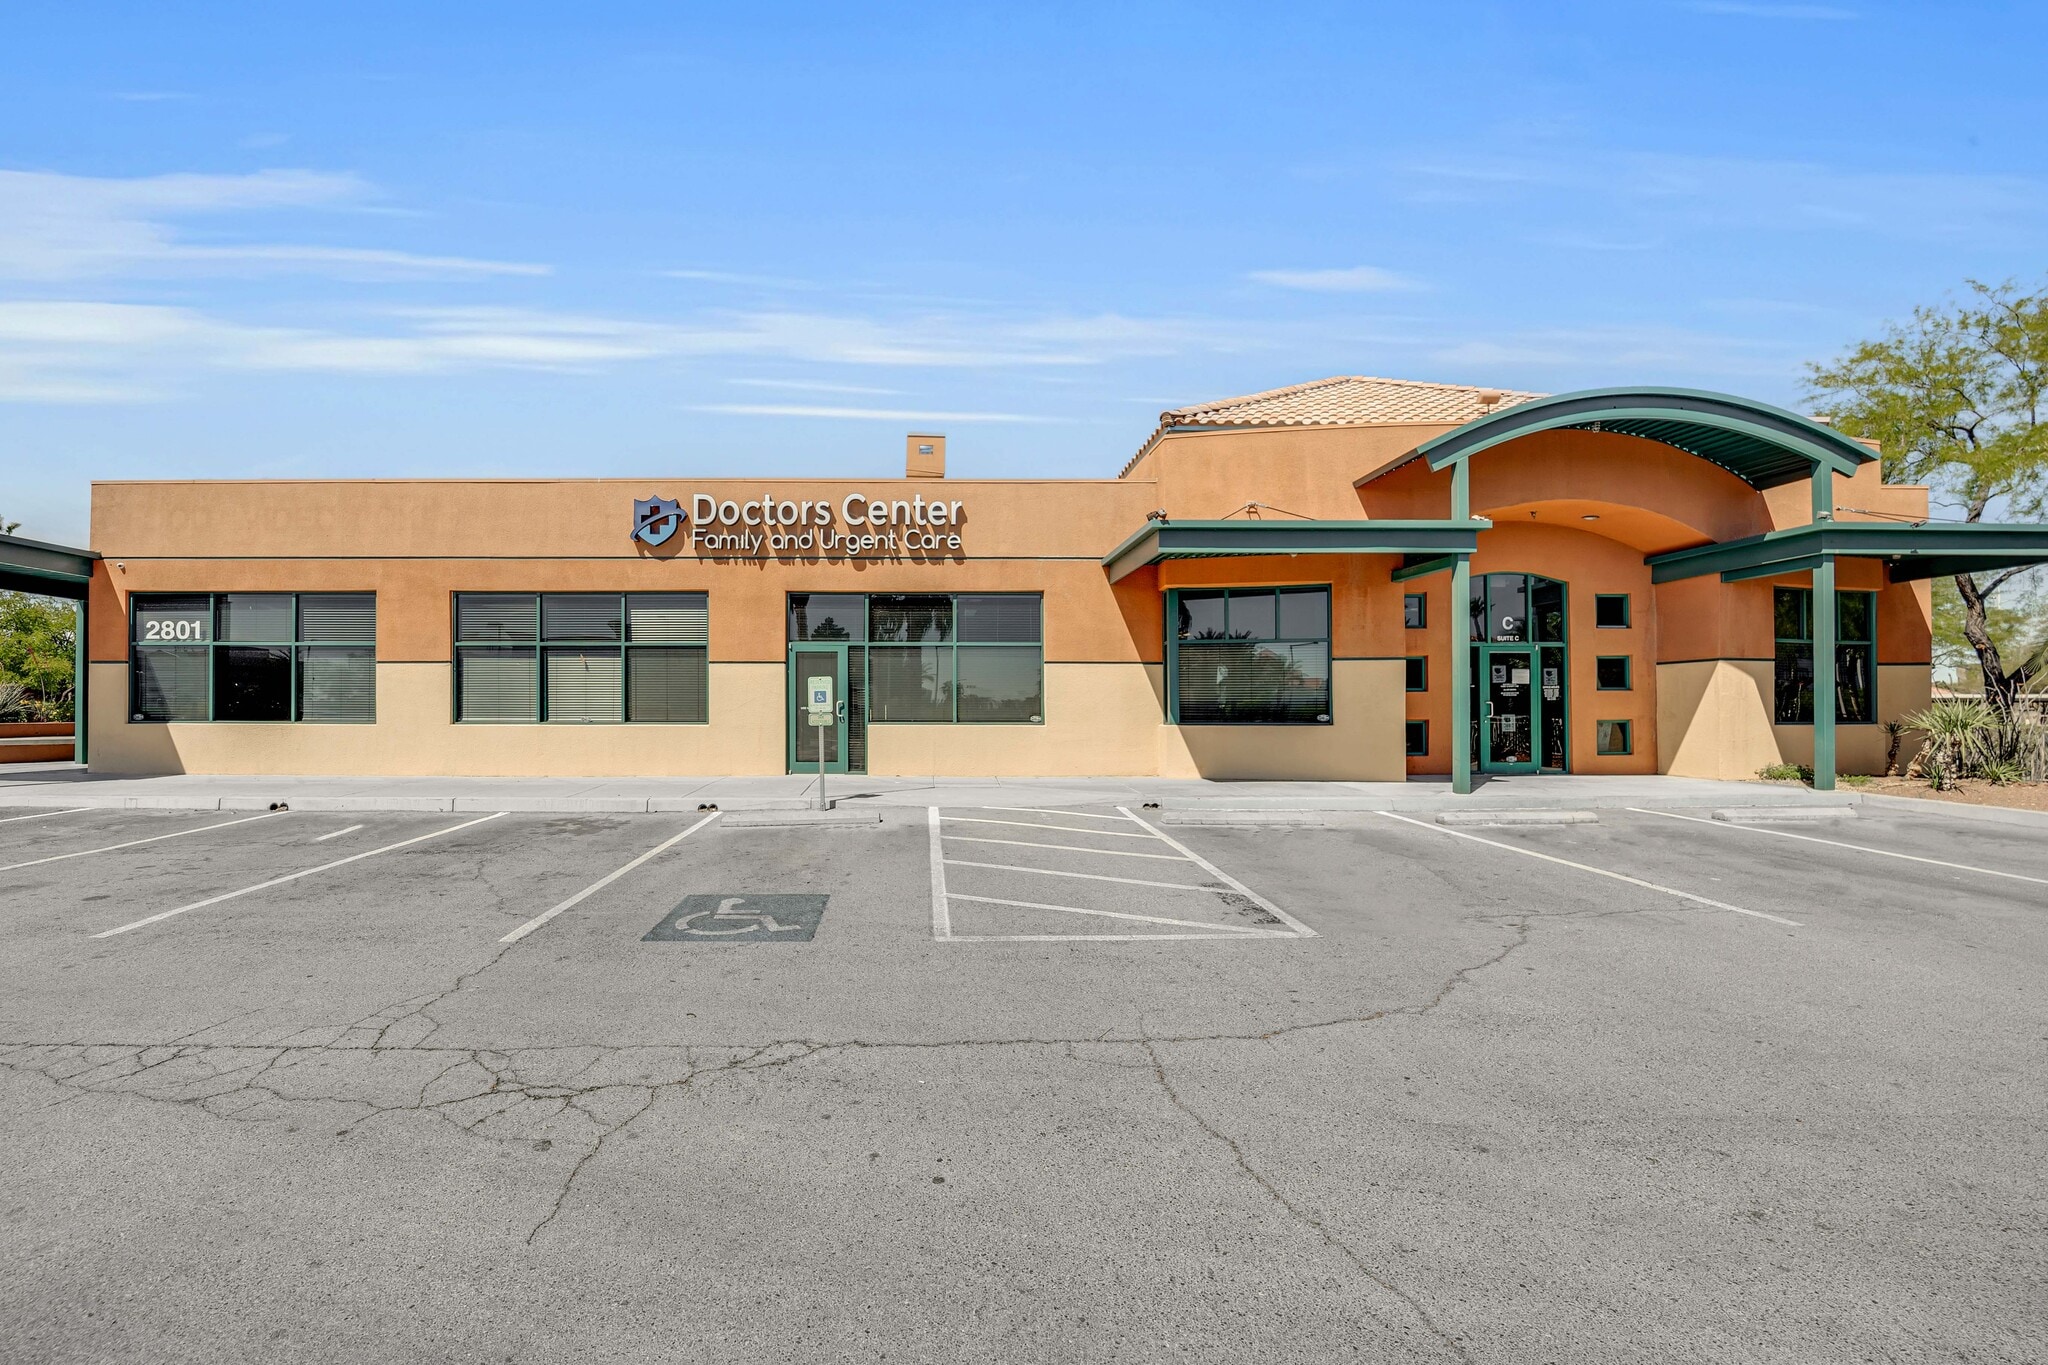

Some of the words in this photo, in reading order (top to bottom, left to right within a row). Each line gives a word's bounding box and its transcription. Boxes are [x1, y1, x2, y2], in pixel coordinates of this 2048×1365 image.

[693, 493, 831, 526] Doctors
[841, 493, 963, 526] Center
[692, 528, 763, 555] Family
[770, 528, 814, 550] and
[820, 528, 897, 555] Urgent
[904, 529, 962, 550] Care
[145, 620, 201, 640] 2801
[1502, 616, 1514, 630] C
